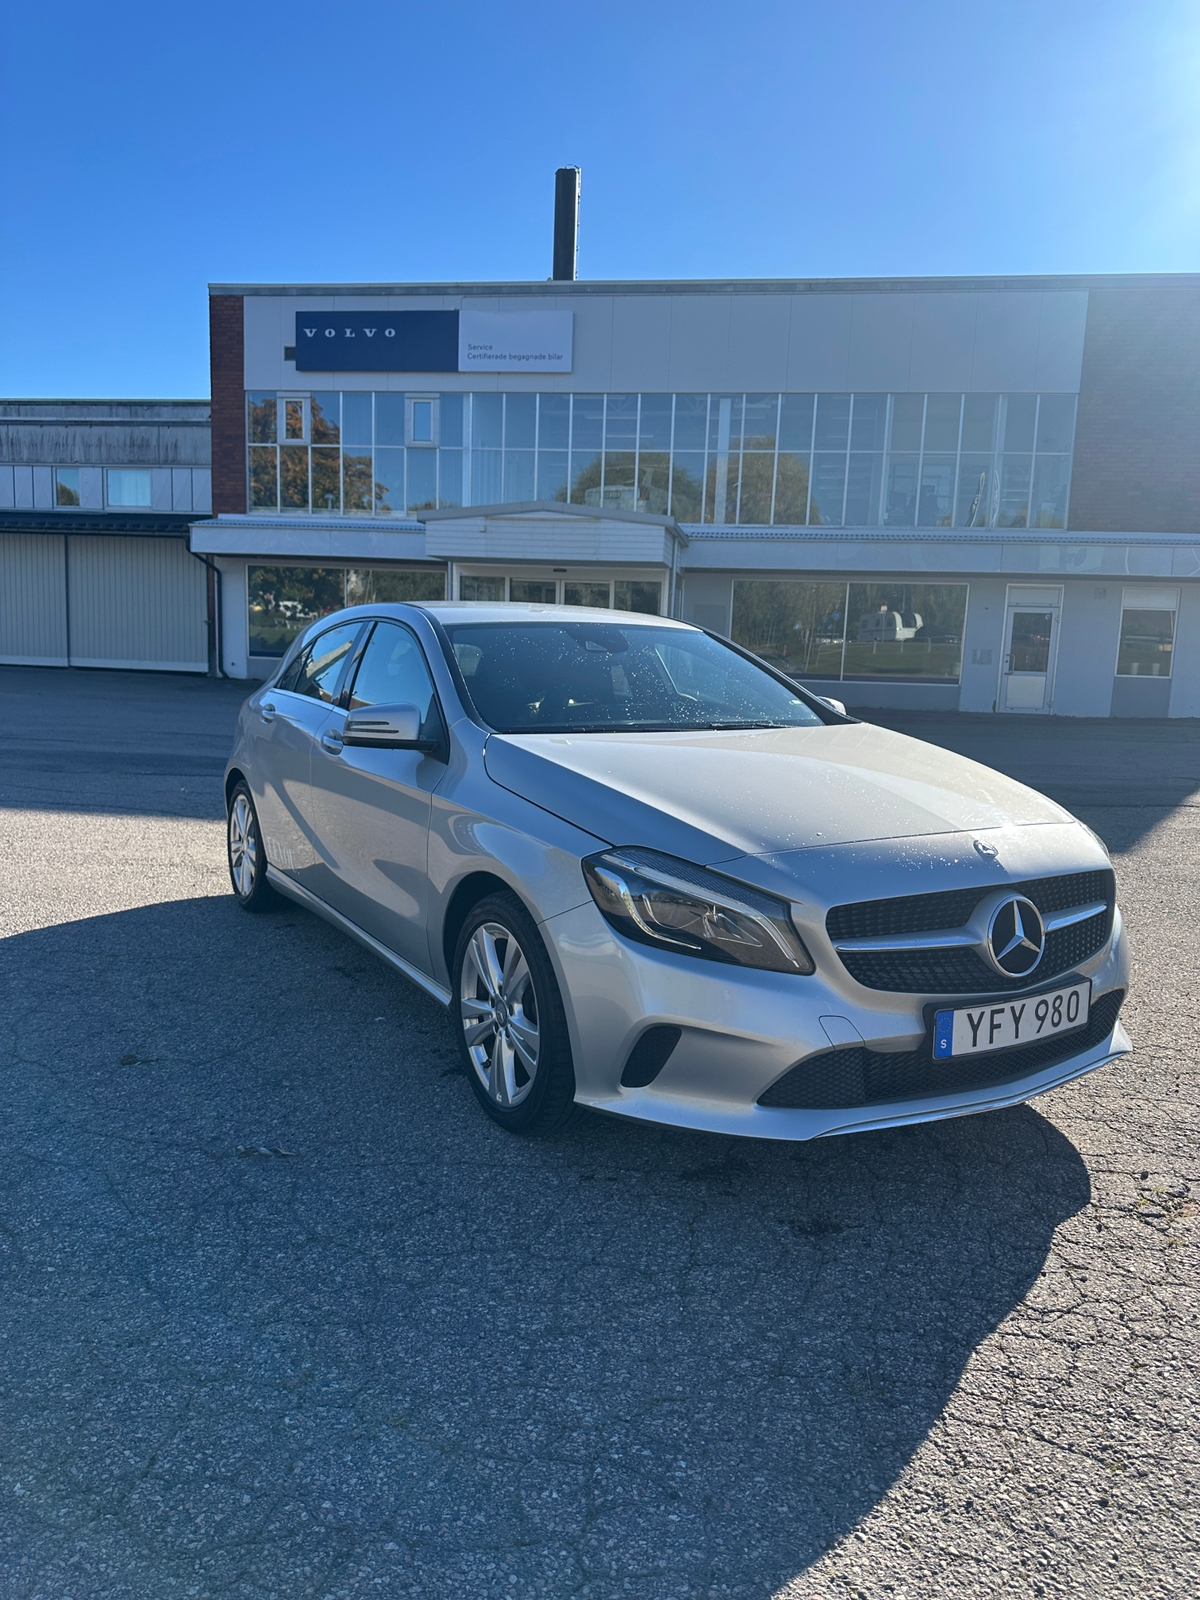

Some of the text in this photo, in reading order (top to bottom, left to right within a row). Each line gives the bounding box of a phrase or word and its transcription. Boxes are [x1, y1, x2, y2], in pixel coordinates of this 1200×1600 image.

[303, 328, 396, 338] VOLVO
[467, 343, 494, 351] Service
[467, 352, 564, 361] Certifierade begagnade bilar
[966, 990, 1080, 1048] YFY 980
[940, 1038, 947, 1049] S
